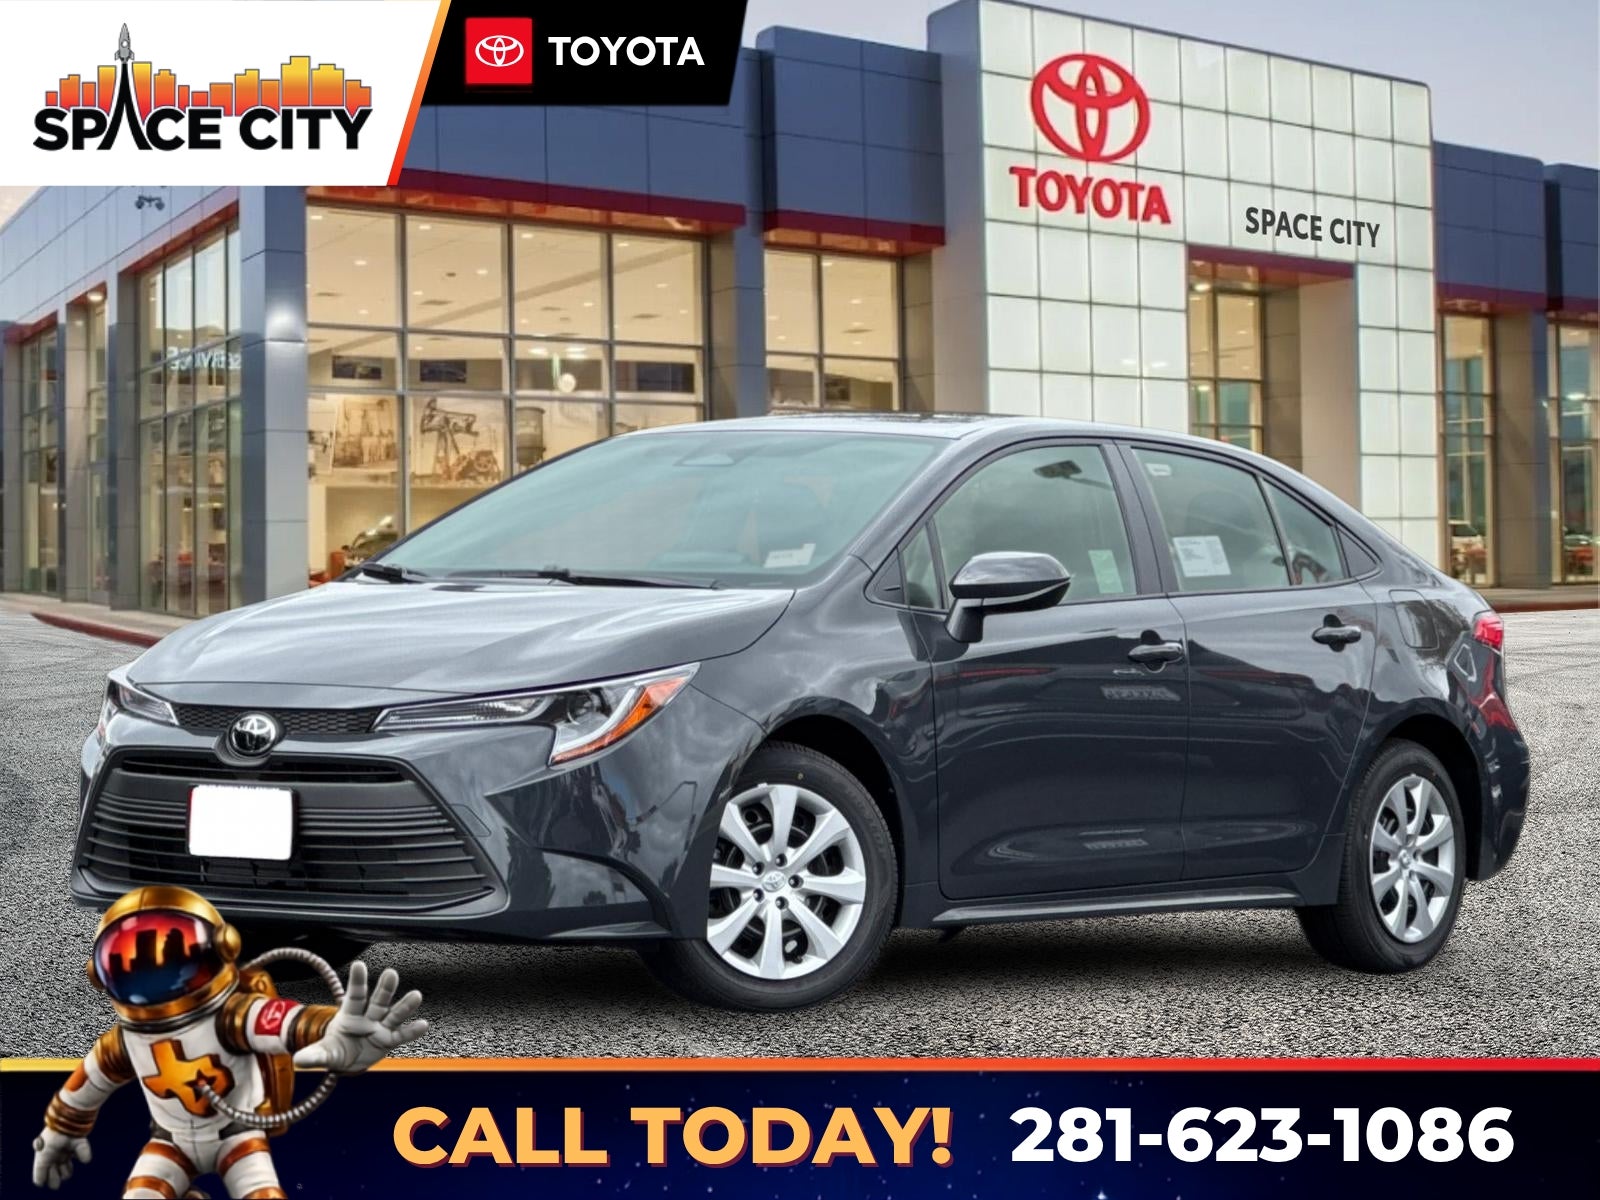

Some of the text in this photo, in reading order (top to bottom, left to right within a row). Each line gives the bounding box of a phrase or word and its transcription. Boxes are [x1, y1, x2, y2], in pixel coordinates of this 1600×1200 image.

[1009, 166, 1171, 224] TOYOTA
[1245, 206, 1381, 248] SPACE CITY
